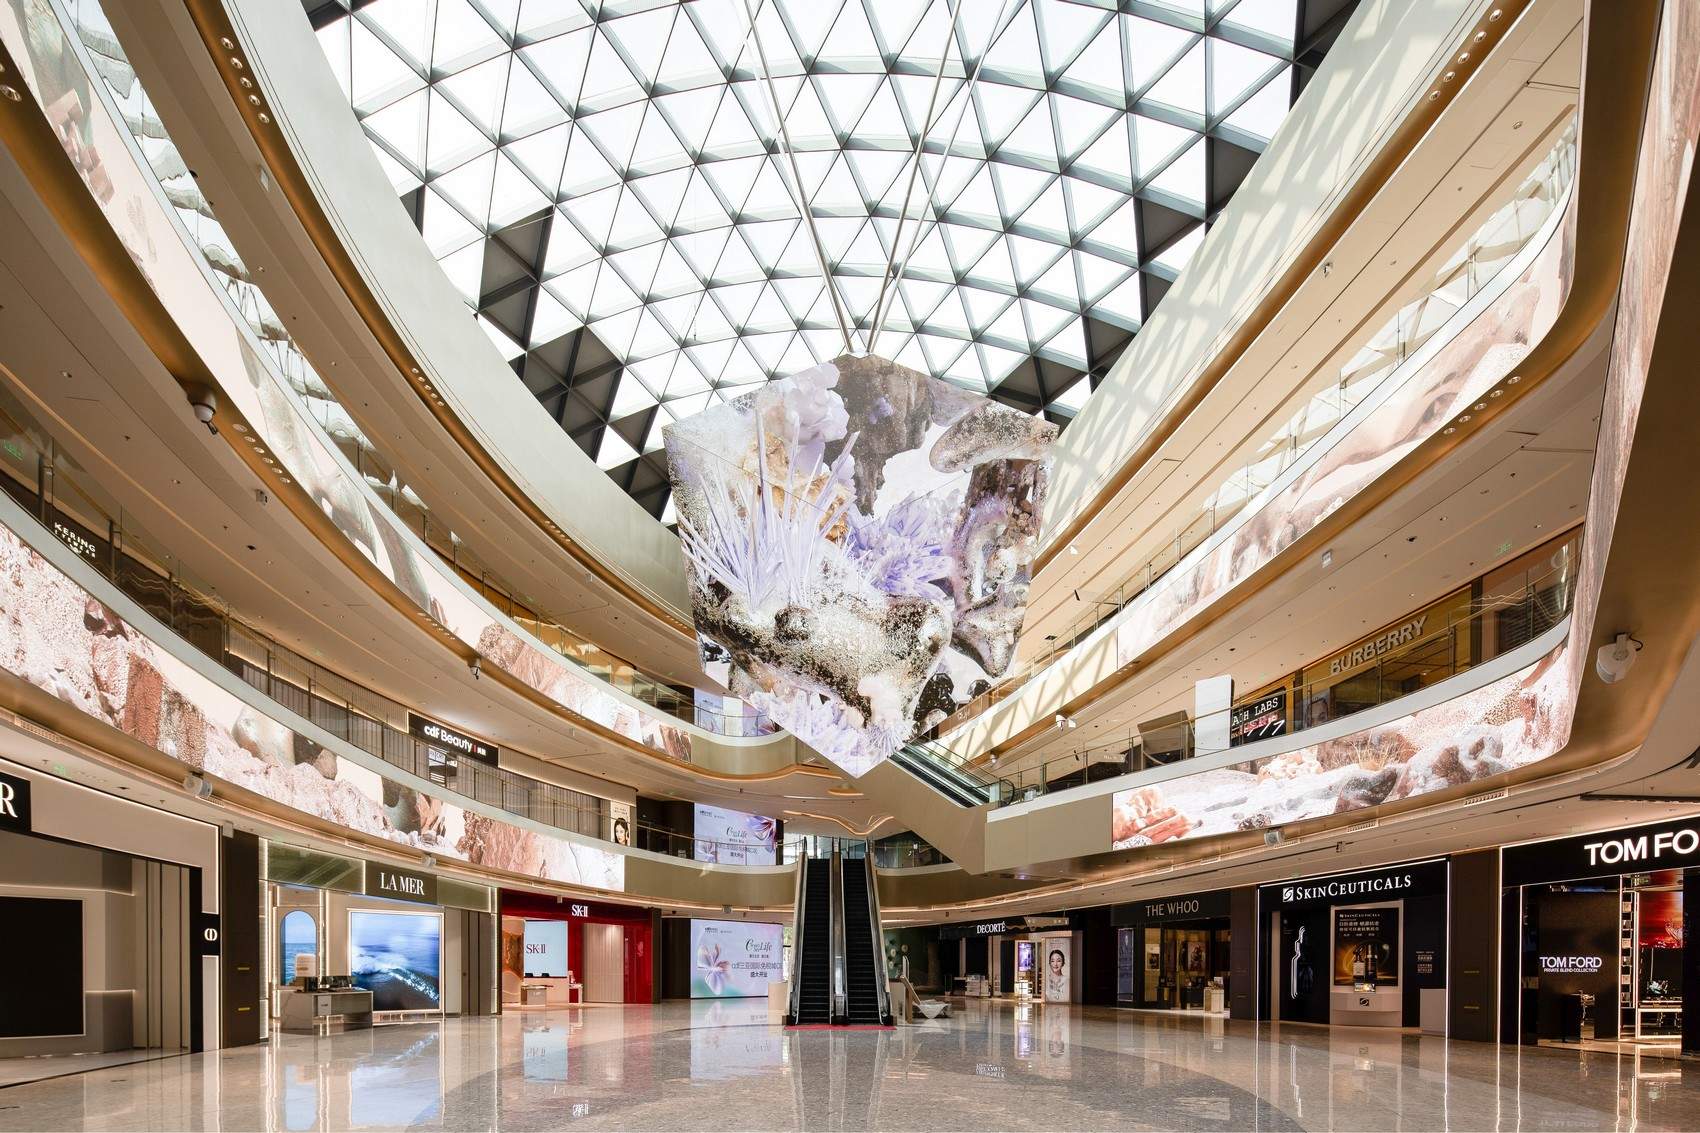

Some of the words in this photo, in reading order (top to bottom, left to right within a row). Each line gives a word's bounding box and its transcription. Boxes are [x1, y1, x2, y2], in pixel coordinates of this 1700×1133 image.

[54, 521, 96, 552] KERING
[1330, 615, 1428, 676] BURBERRY
[1254, 697, 1278, 716] LABS
[424, 725, 440, 739] cdf
[440, 729, 473, 753] Beauty
[1584, 836, 1647, 866] TOM
[1654, 829, 1700, 858] FO
[380, 872, 397, 891] LA
[400, 876, 425, 895] MER
[1145, 903, 1165, 917] THE
[1167, 900, 1199, 915] WHOO
[976, 921, 1005, 934] DECORTÉ
[1540, 956, 1566, 968] TOM
[1568, 956, 1602, 968] FORD
